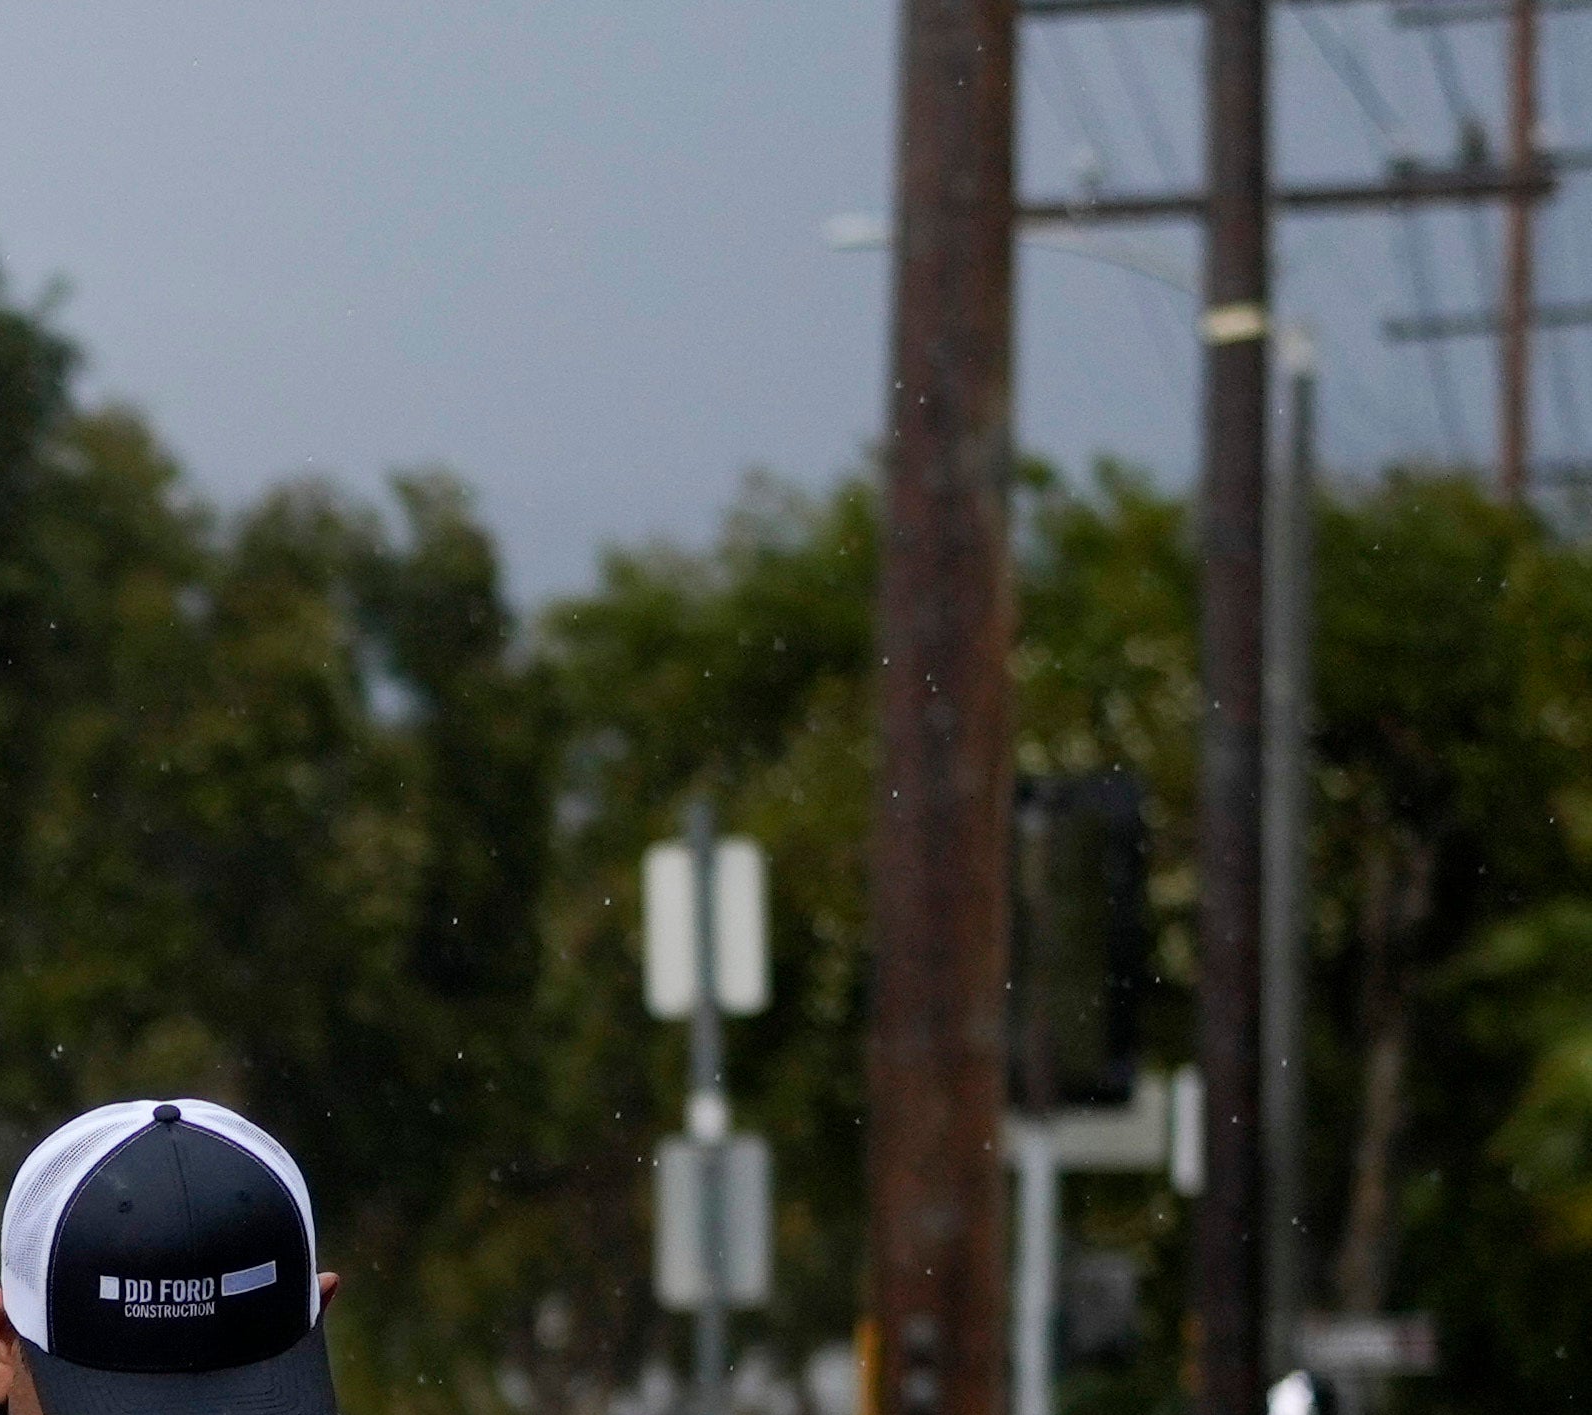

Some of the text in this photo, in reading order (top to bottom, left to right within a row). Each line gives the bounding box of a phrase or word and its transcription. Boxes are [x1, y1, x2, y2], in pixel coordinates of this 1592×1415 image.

[125, 1277, 215, 1303] DD FORD
[124, 1302, 216, 1318] CONSTRUCTION
